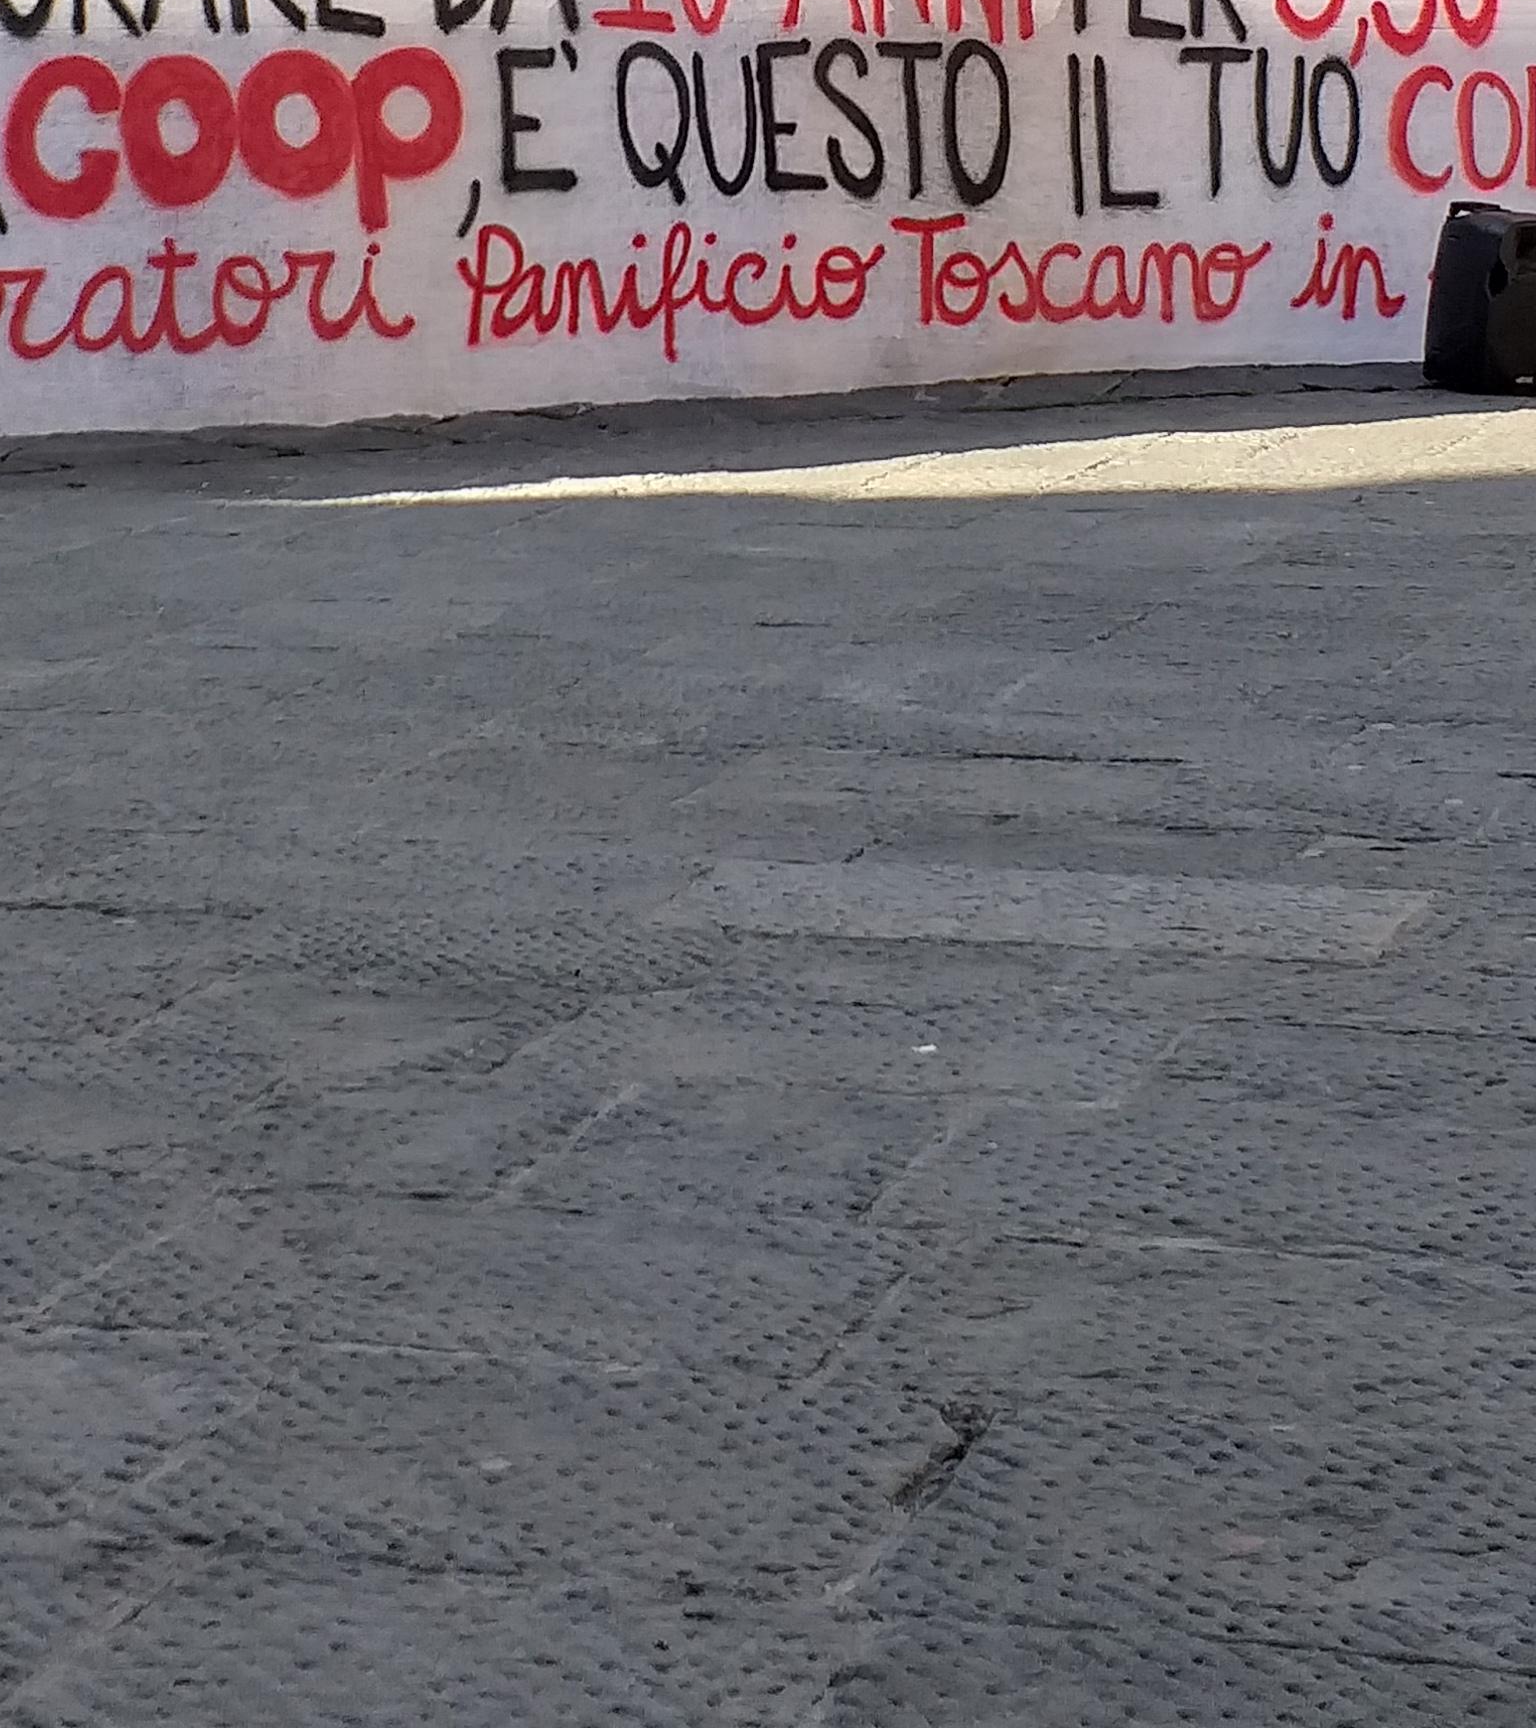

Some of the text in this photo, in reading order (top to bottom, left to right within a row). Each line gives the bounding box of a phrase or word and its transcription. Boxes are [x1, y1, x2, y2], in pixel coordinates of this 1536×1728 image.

[617, 37, 1011, 207] QUESTO
[1068, 51, 1162, 216] IL
[1179, 44, 1364, 189] TUO
[456, 220, 887, 364] Panificio
[889, 211, 1271, 328] Toscano
[1290, 211, 1406, 320] in
